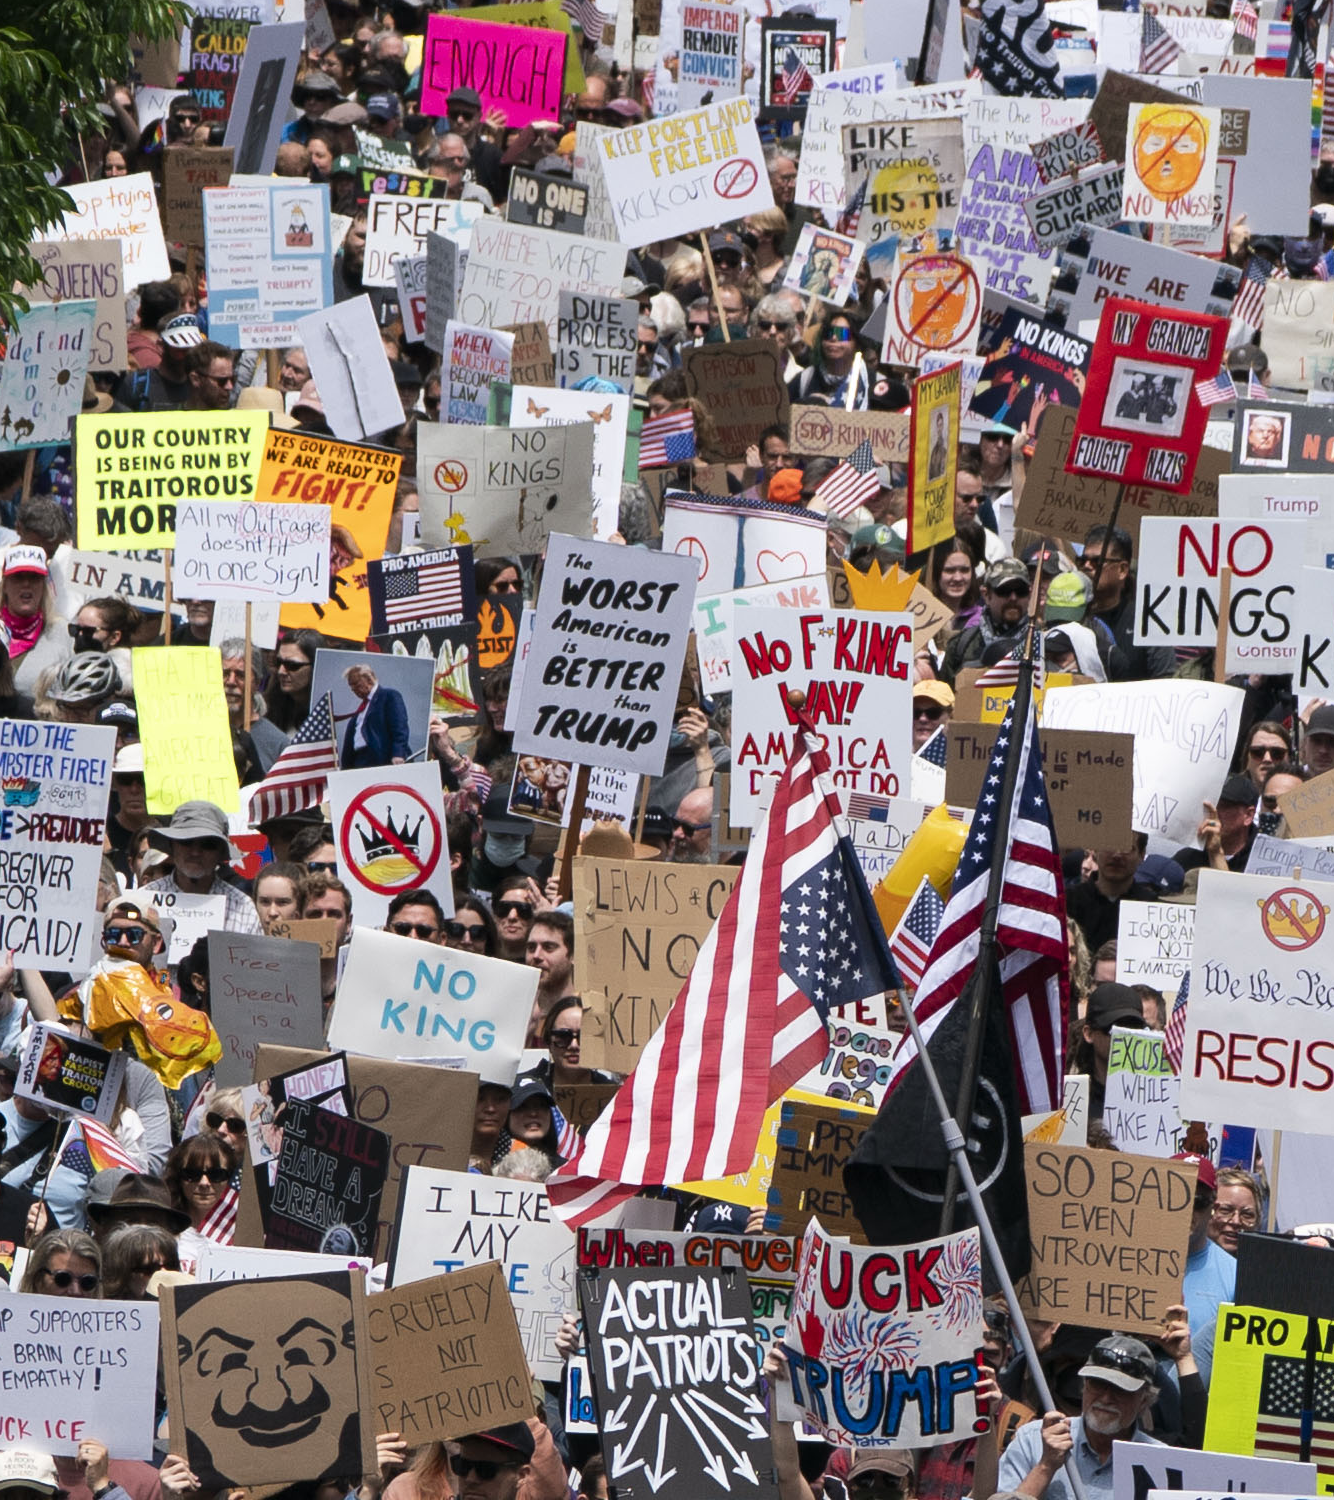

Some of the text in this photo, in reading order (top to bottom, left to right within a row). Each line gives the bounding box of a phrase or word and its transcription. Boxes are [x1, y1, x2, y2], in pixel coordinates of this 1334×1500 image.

[683, 7, 739, 30] IMPEACH
[683, 32, 738, 54] REMOVE
[429, 38, 558, 114] ENOUGH.
[682, 54, 738, 77] CONVICT
[603, 101, 753, 160] KEEP PORTLAND
[850, 127, 915, 150] LIKE
[649, 134, 740, 178] FREE!!!
[511, 180, 585, 215] NO ONE
[617, 180, 709, 223] KICK OUT
[865, 187, 956, 212] HIS TIE
[870, 218, 926, 241] grows
[1015, 317, 1087, 365] NO KINGS
[1113, 314, 1210, 358] MY GRANDPA
[96, 428, 250, 448] OUR COUNTRY
[799, 420, 832, 442] STOP
[97, 452, 250, 471] IS BEING RUN BY
[1076, 436, 1187, 481] FOUGHT NAZIS
[96, 476, 253, 499] TRAITOROUS
[272, 470, 375, 510] FIGHT!
[1264, 497, 1319, 515] Trump
[181, 507, 324, 541] All my Outrage
[381, 550, 458, 570] PRO-AMERICA
[566, 554, 592, 571] The
[1177, 525, 1274, 577] NO
[184, 553, 321, 595] on one Sign!
[562, 577, 677, 613] WORST
[552, 610, 672, 647] American
[1141, 585, 1295, 640] KINGS
[562, 640, 576, 653] is
[543, 655, 664, 691] BETTER
[614, 695, 651, 714] than
[1, 721, 74, 753] END THE
[533, 705, 658, 752] TRUMP
[60, 755, 106, 787] FIRE!
[1202, 960, 1245, 1000] We
[1249, 966, 1286, 1001] the
[30, 1308, 141, 1332] SUPPORTERS
[600, 1276, 746, 1334] ACTUAL
[14, 1344, 64, 1366] BRAIN
[74, 1346, 127, 1367] CELLS
[602, 1331, 764, 1388] PATRIOTS.
[3, 1368, 101, 1391] EMPATHY!
